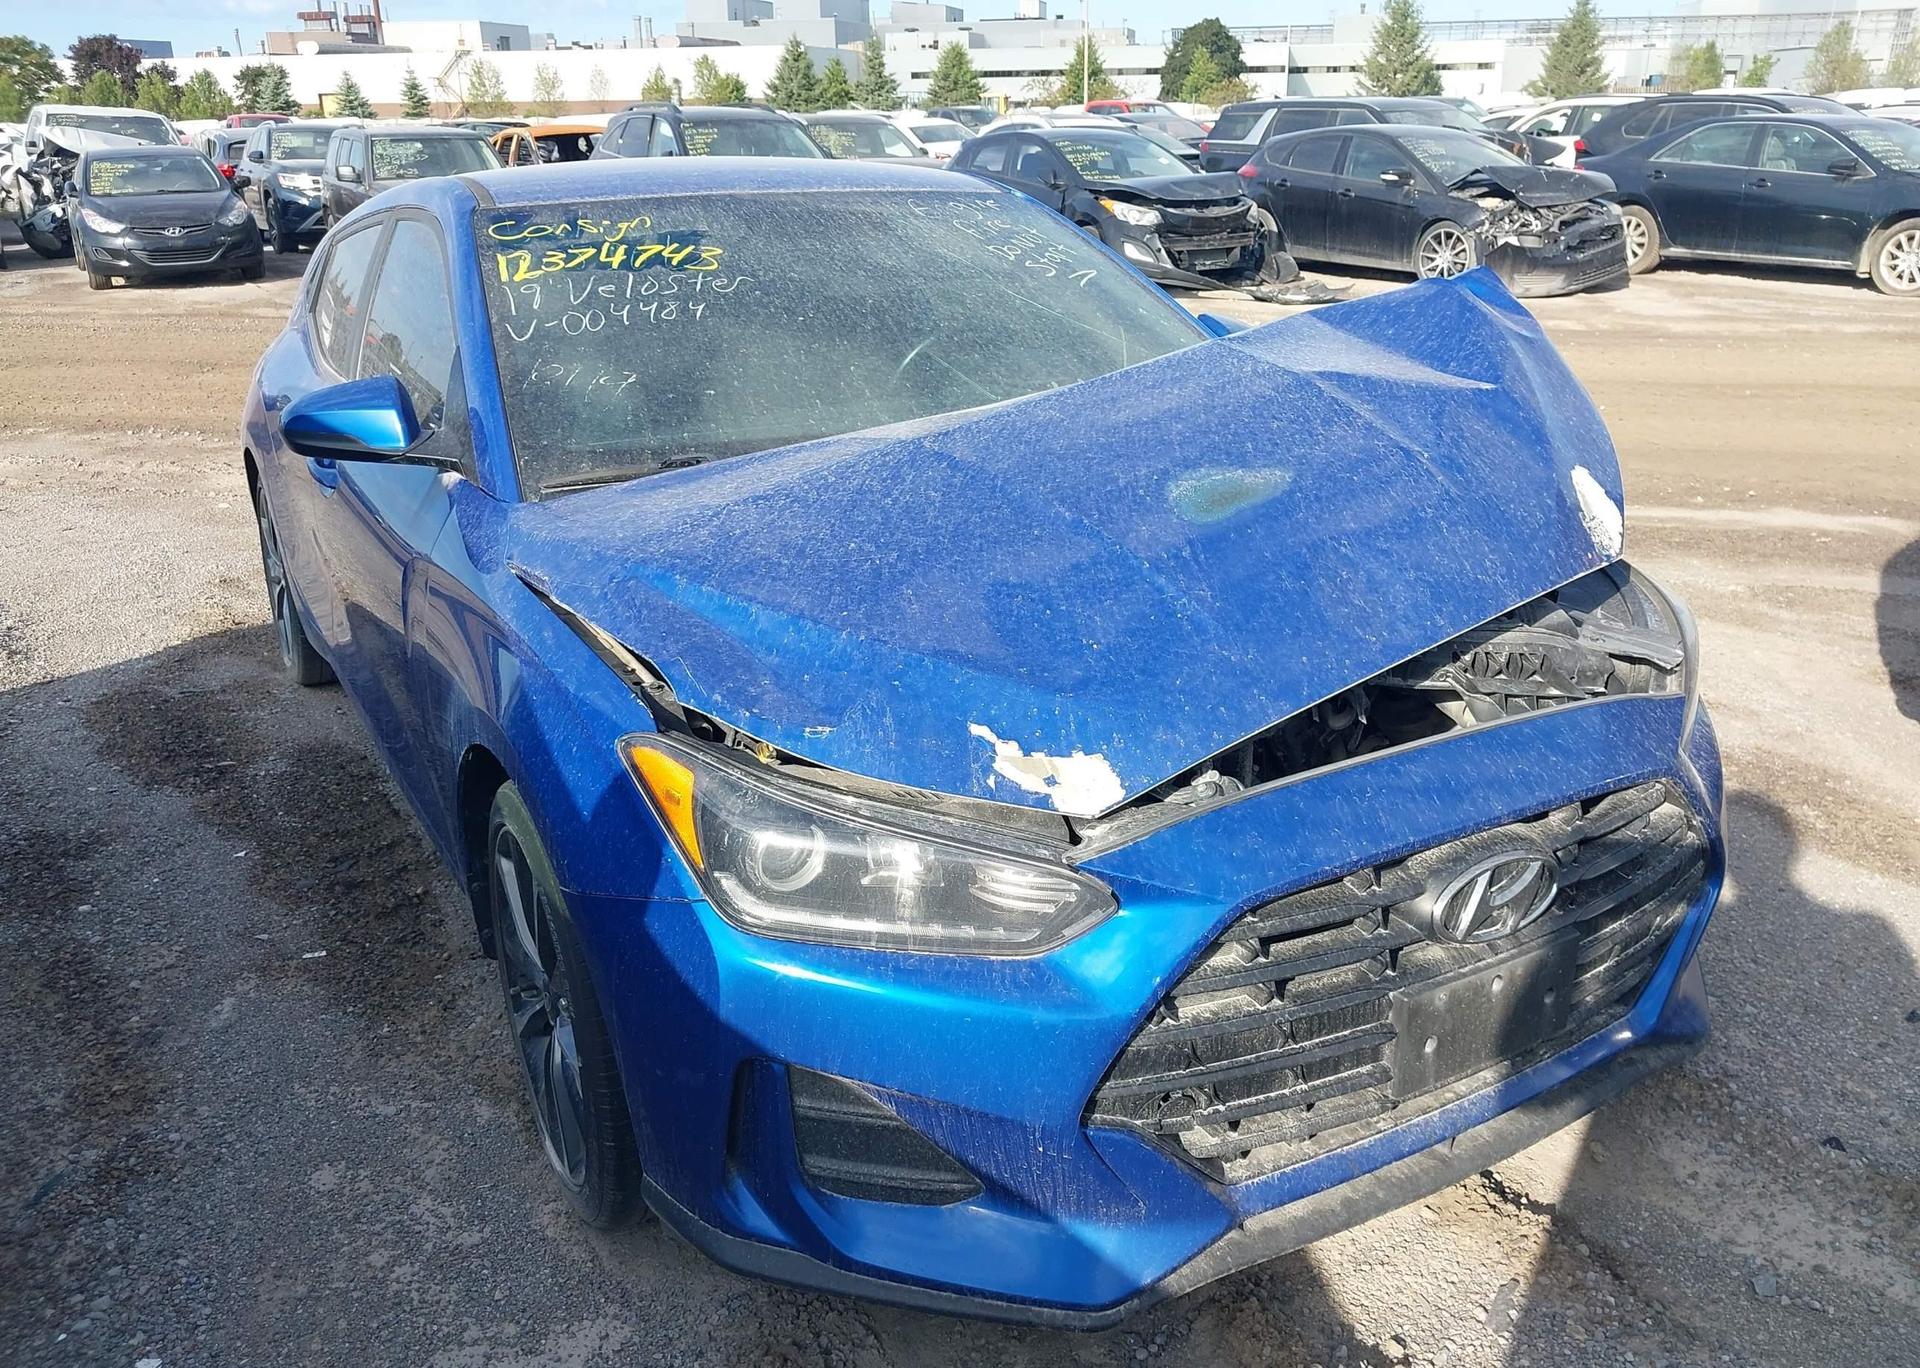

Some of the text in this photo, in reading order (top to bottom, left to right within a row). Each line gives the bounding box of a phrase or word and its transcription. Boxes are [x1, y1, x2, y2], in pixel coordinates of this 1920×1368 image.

[488, 216, 652, 241] Consign
[1024, 242, 1078, 278] Start
[566, 272, 755, 305] Veloster
[505, 301, 707, 342] V-004484
